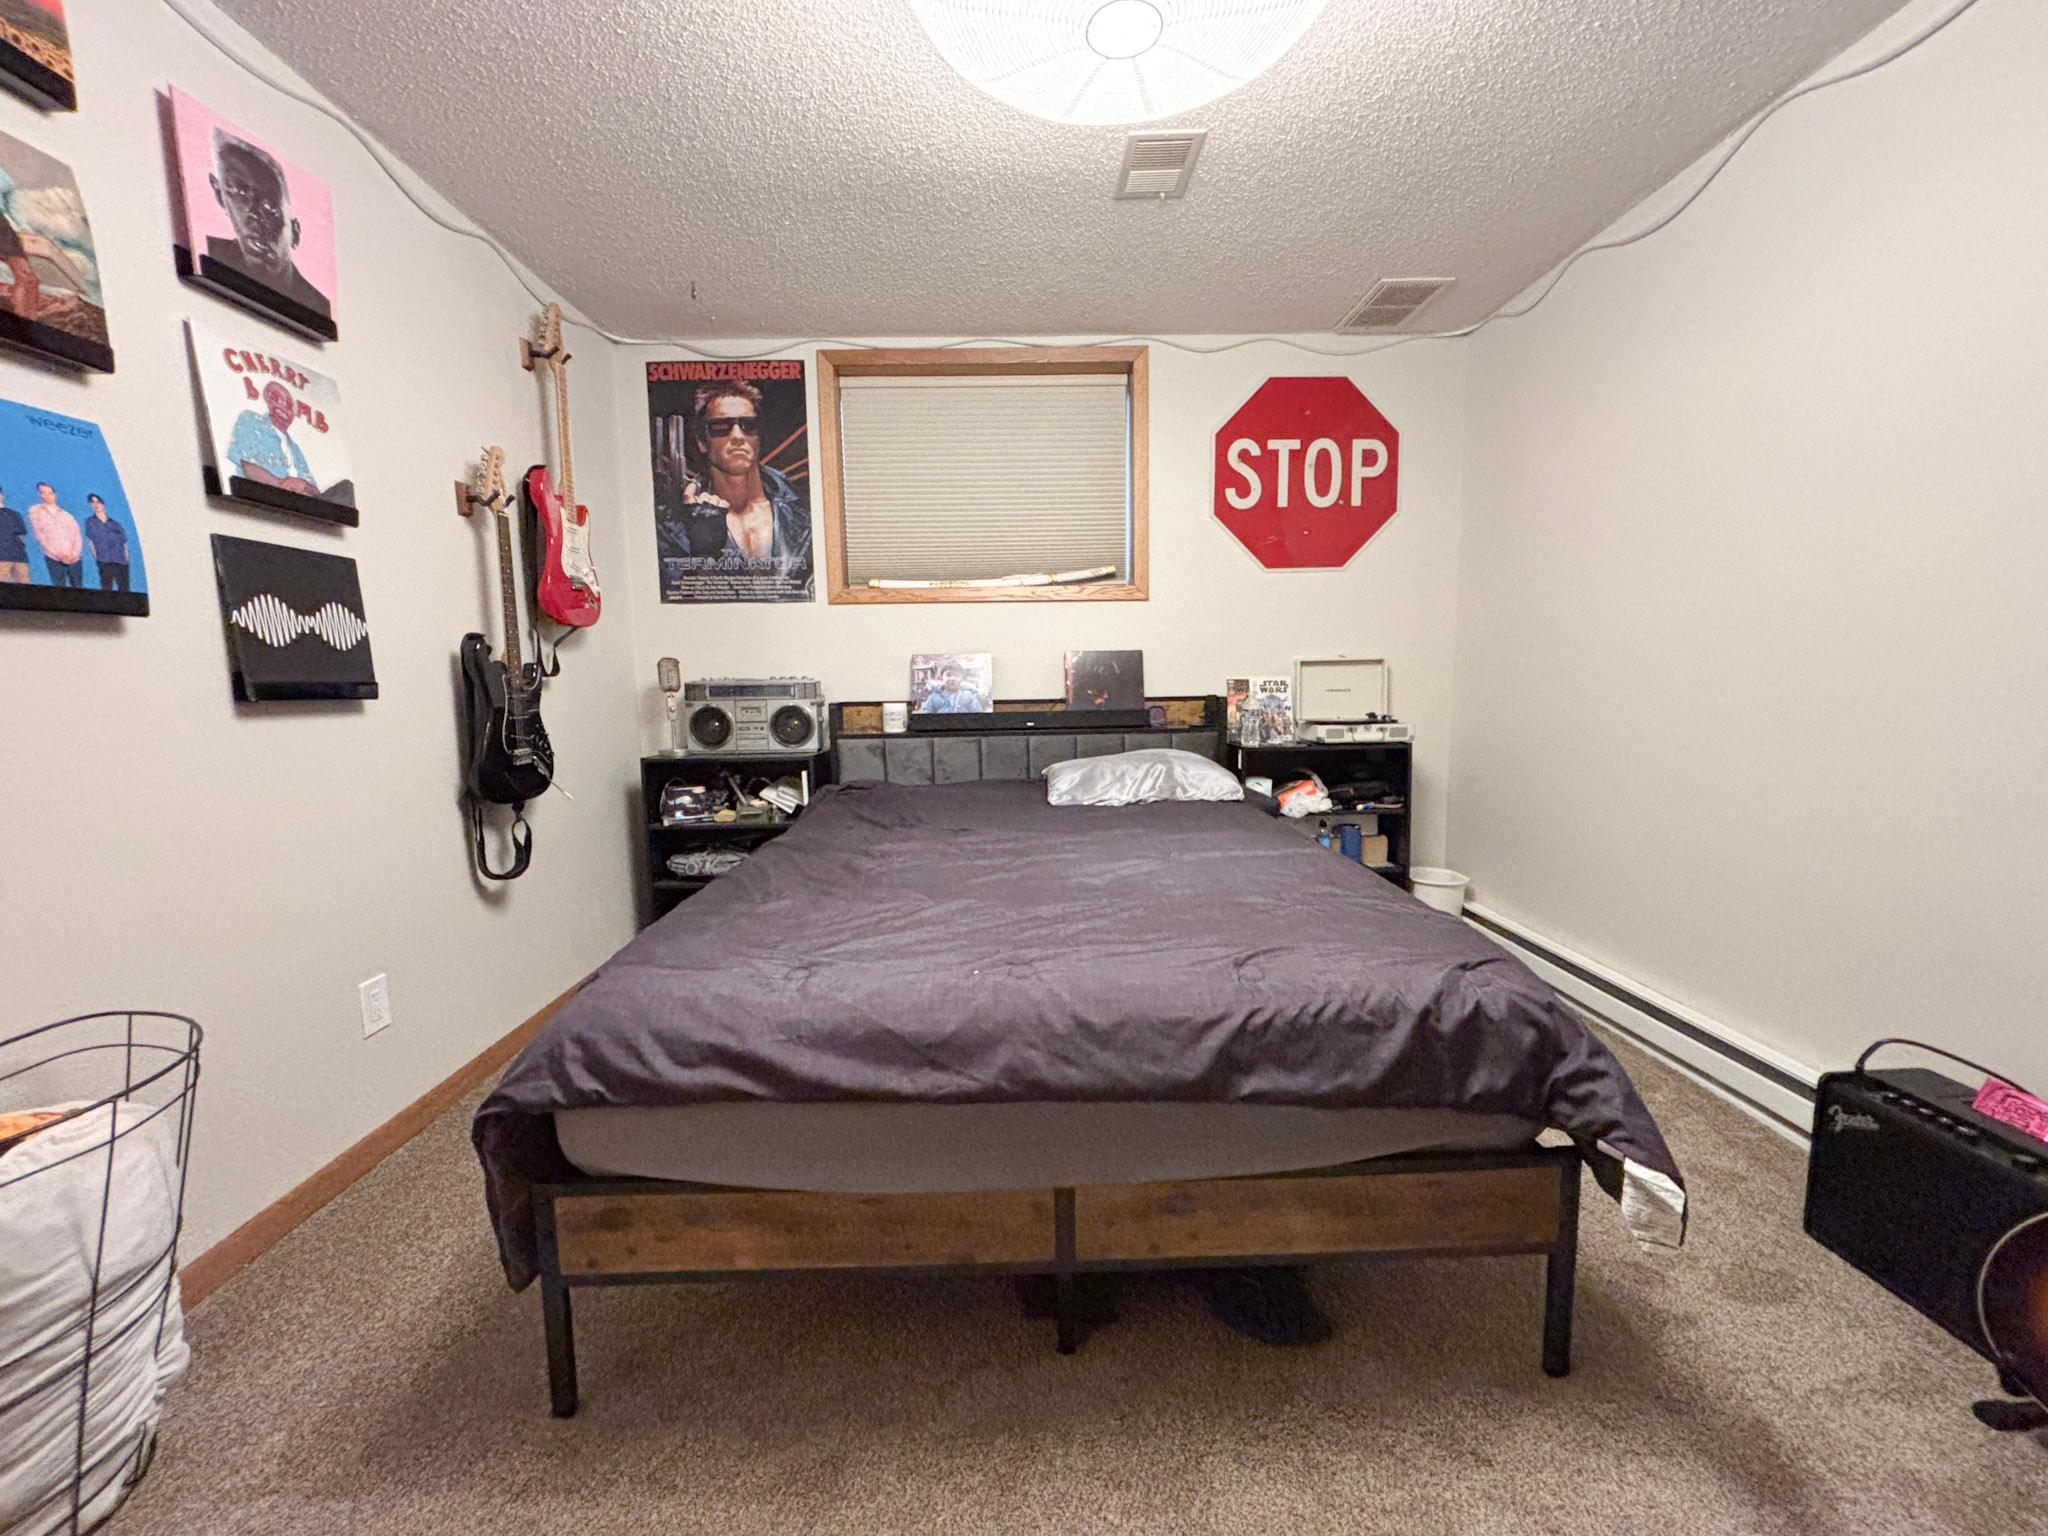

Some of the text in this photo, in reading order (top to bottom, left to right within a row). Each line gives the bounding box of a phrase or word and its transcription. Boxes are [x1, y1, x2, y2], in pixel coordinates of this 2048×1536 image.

[648, 361, 801, 381] SCHWARZENEGGER
[1224, 437, 1389, 510] STOP
[663, 556, 808, 570] TERMINATOR
[1260, 686, 1289, 694] WARS
